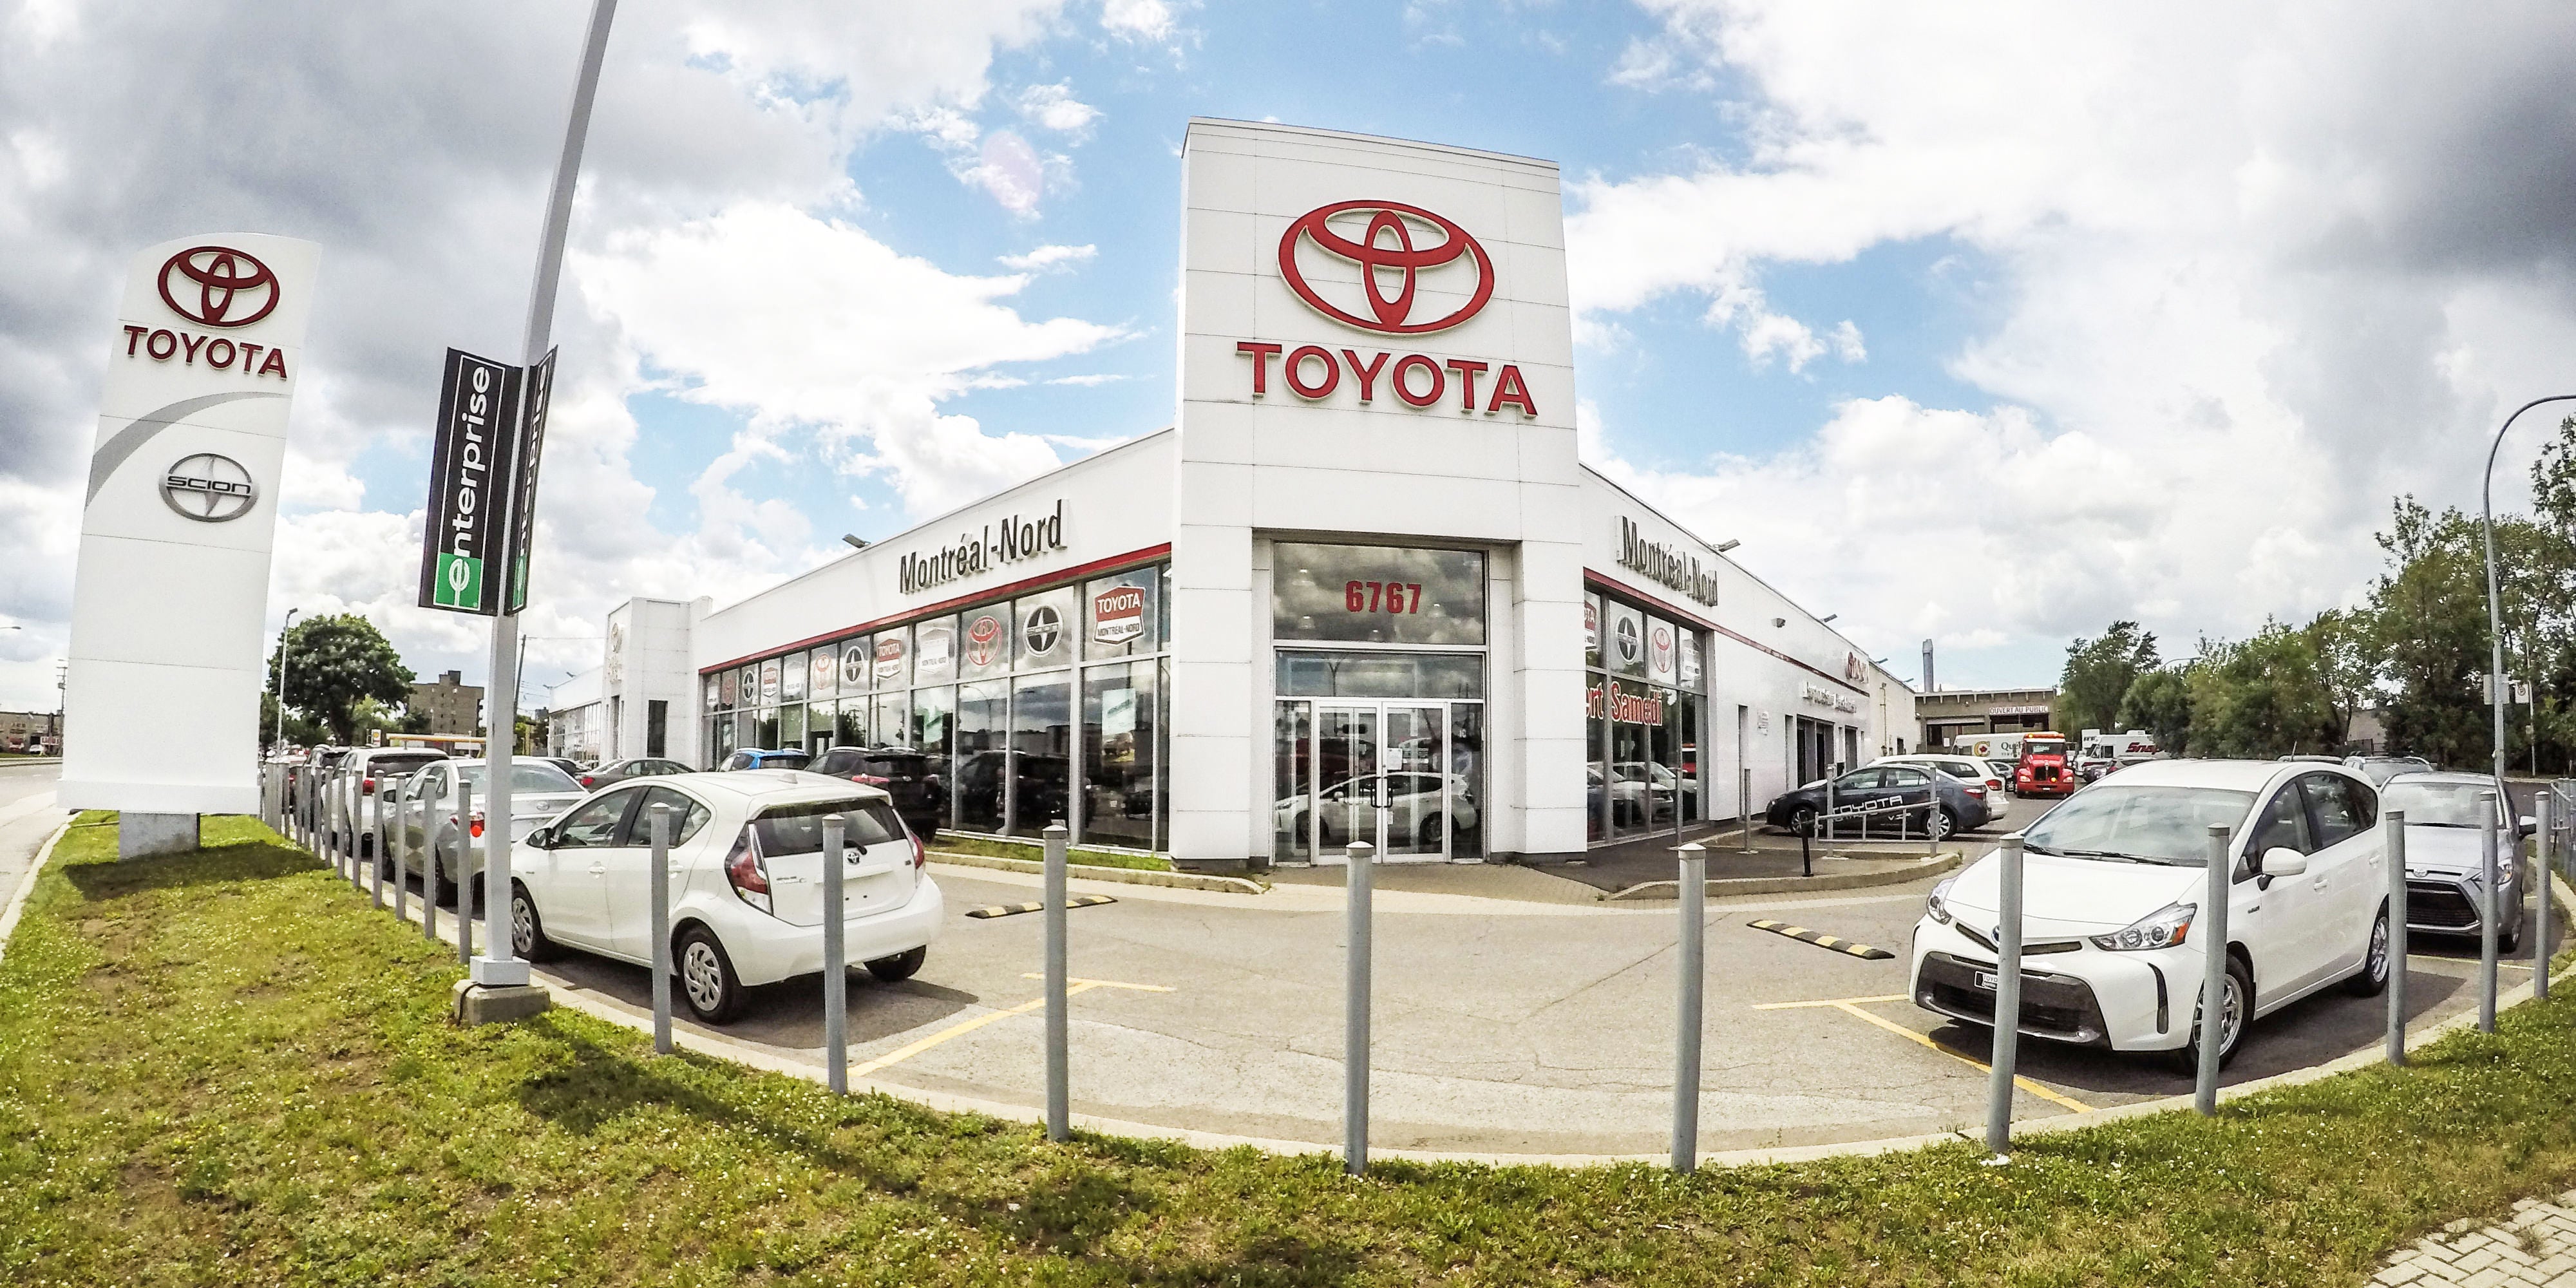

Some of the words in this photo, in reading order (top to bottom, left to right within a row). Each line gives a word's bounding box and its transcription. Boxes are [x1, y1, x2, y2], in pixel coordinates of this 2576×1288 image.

[124, 325, 287, 381] TOYOTA
[1236, 341, 1538, 418] TOYOTA
[167, 476, 251, 494] SCION
[448, 366, 491, 607] enterprise
[900, 500, 1064, 594] Montréal-Nord
[1621, 515, 1718, 607] Montréal-Nord
[1097, 592, 1141, 614] TOYOTA
[1345, 580, 1422, 614] 6767
[1611, 681, 1663, 726] Samedi
